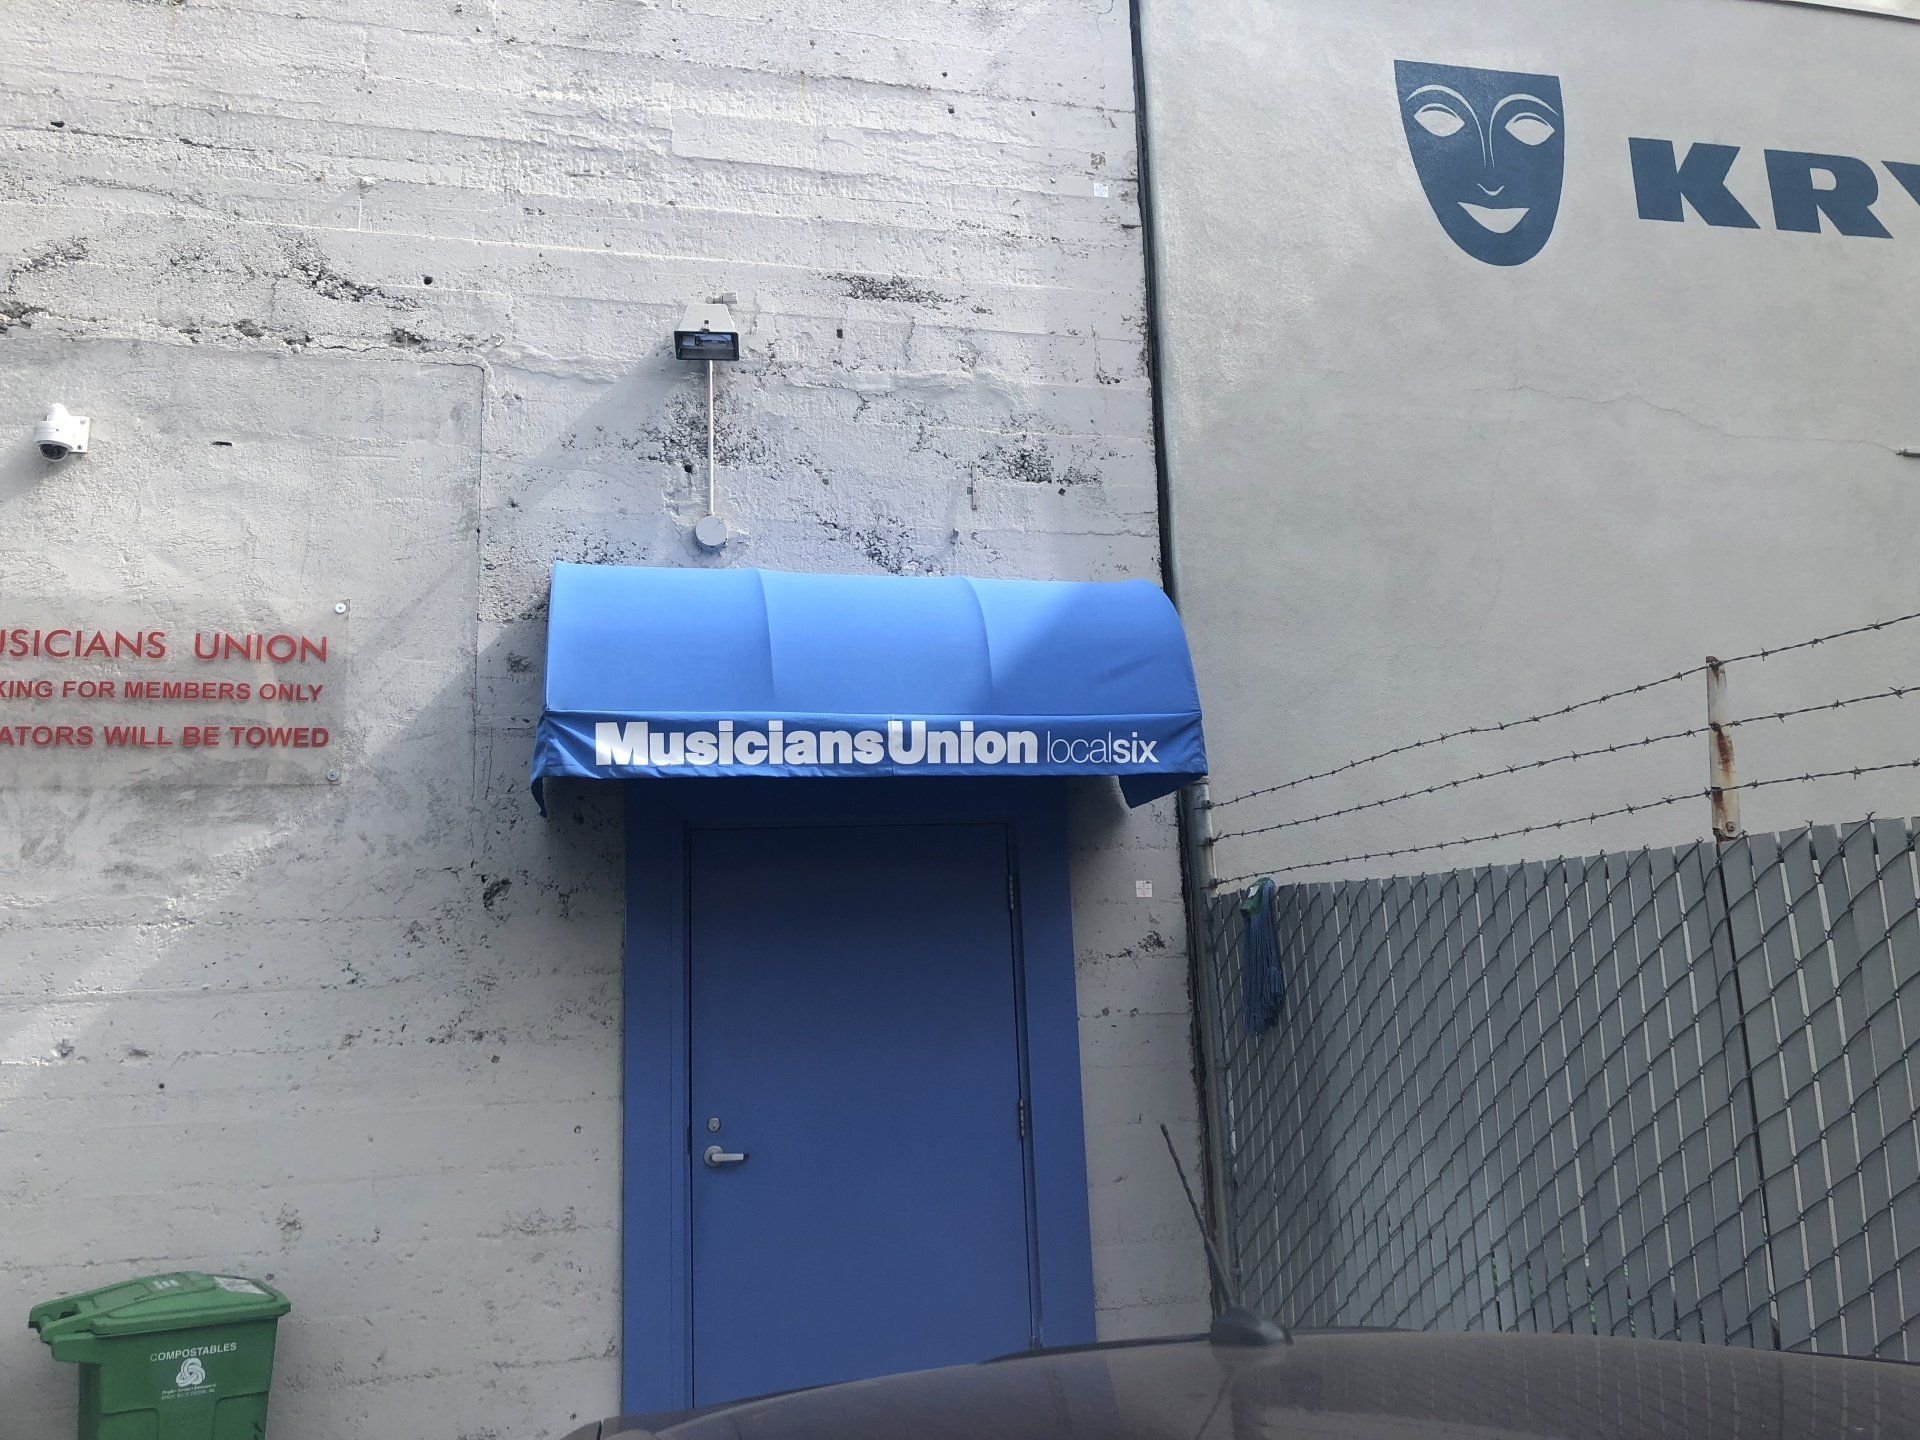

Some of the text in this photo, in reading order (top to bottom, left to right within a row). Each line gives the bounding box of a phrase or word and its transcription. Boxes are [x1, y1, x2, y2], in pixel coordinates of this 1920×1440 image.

[1628, 136, 1920, 239] KR
[0, 628, 328, 663] SICIANS UNION
[62, 680, 116, 698] FOR
[124, 681, 251, 700] MEMBERS
[259, 683, 324, 701] ONLY
[0, 725, 329, 748] ATORS WILL BE TOWED
[150, 1342, 237, 1361] COMPOSTABLES
